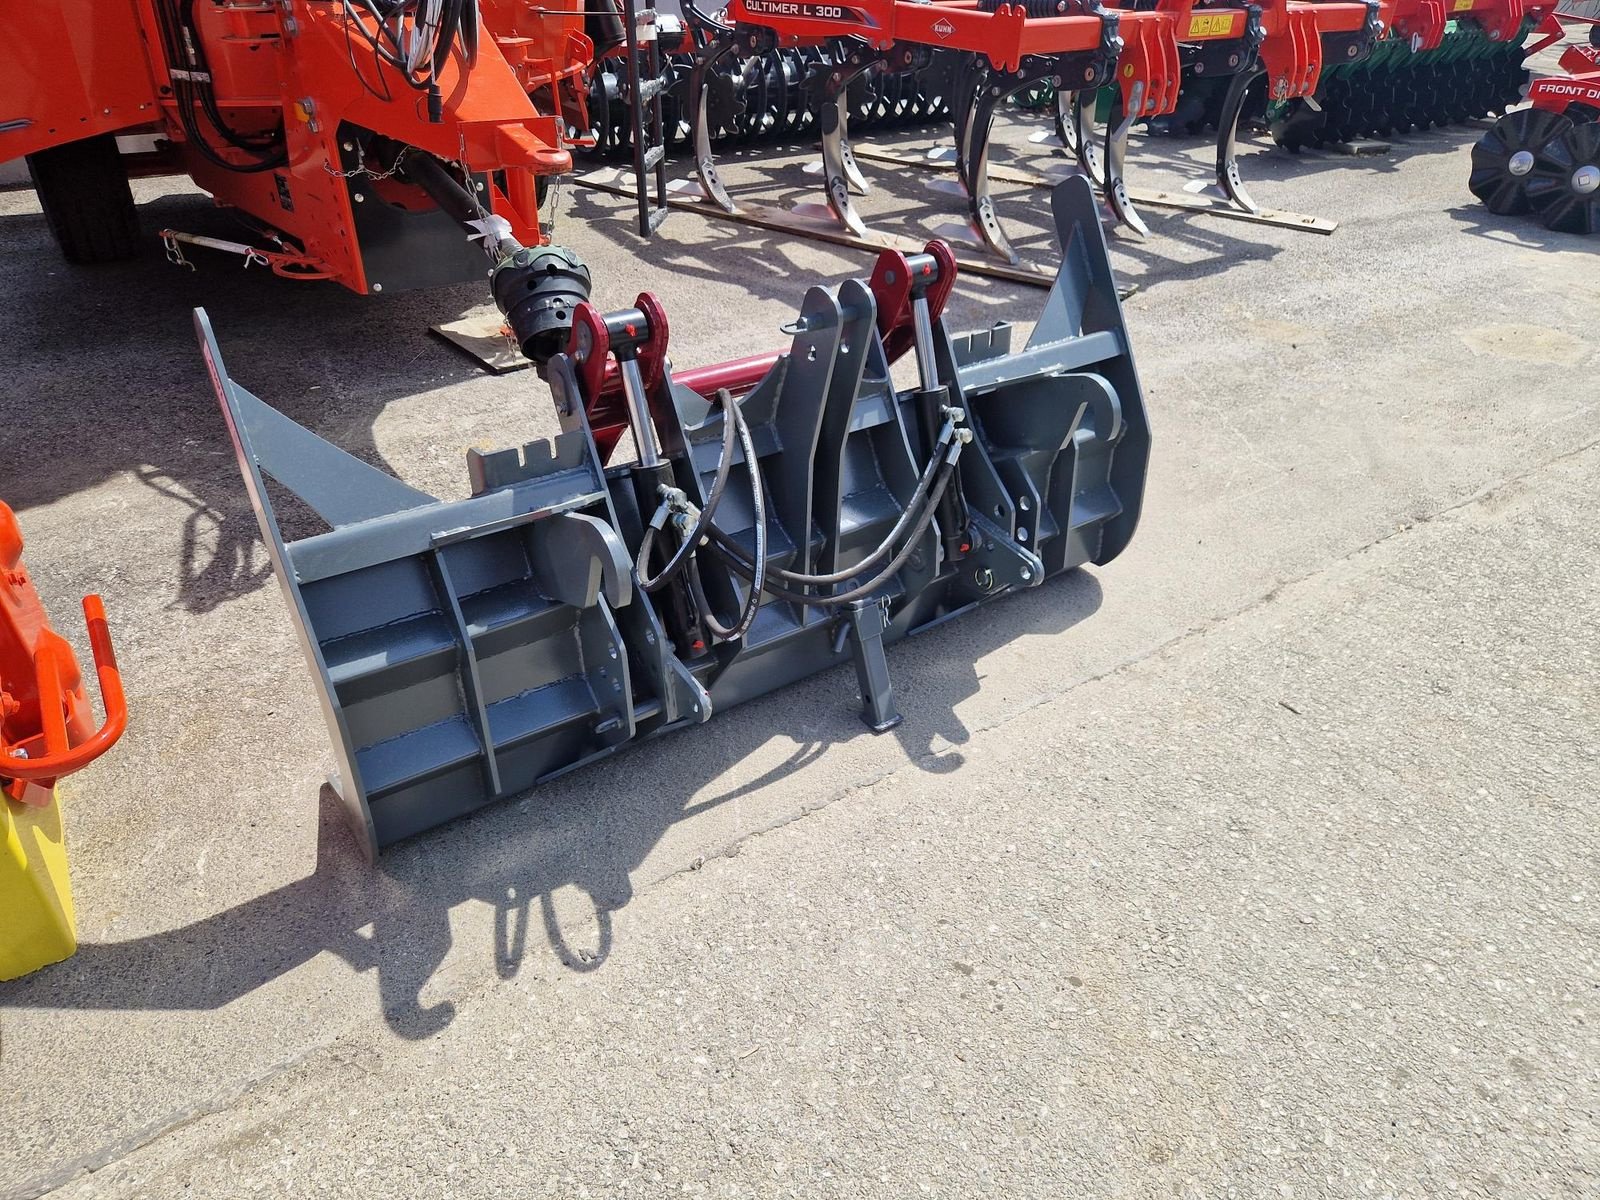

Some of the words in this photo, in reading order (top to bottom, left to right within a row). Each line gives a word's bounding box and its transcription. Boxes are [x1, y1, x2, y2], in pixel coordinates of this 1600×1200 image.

[746, 0, 798, 15] CULTIMER
[803, 5, 811, 15] L
[815, 6, 841, 18] 300
[1538, 84, 1585, 96] FRONT
